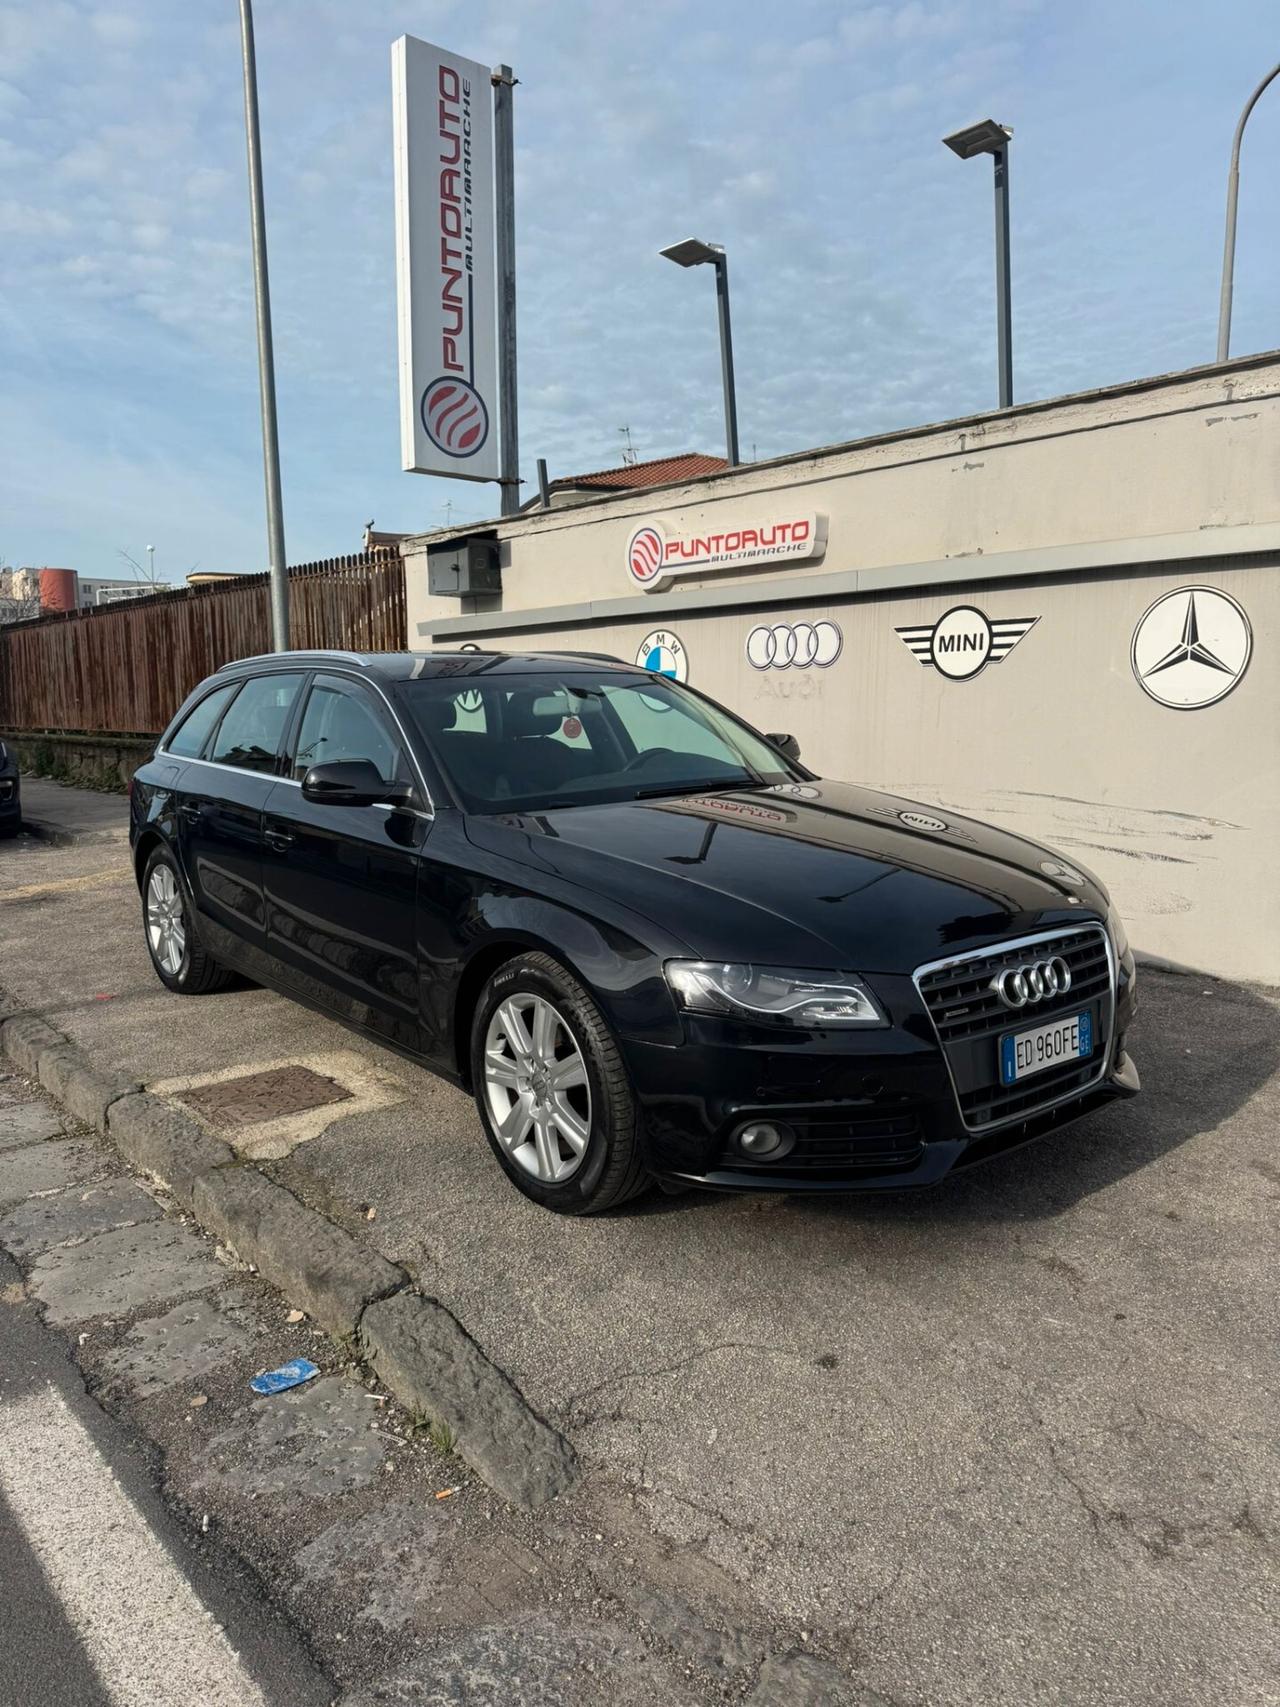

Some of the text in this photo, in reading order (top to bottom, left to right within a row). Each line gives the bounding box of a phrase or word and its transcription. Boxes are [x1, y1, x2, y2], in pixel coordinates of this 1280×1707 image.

[464, 79, 474, 271] MULTIMARCHE
[438, 65, 464, 371] PUNTOAUTO
[665, 520, 809, 560] PUNTOAUTO
[710, 543, 807, 563] MULTIMARCHE
[641, 633, 681, 656] BMW
[938, 632, 985, 653] MINI
[1016, 1039, 1033, 1070] ED
[1037, 1024, 1078, 1062] 960FE
